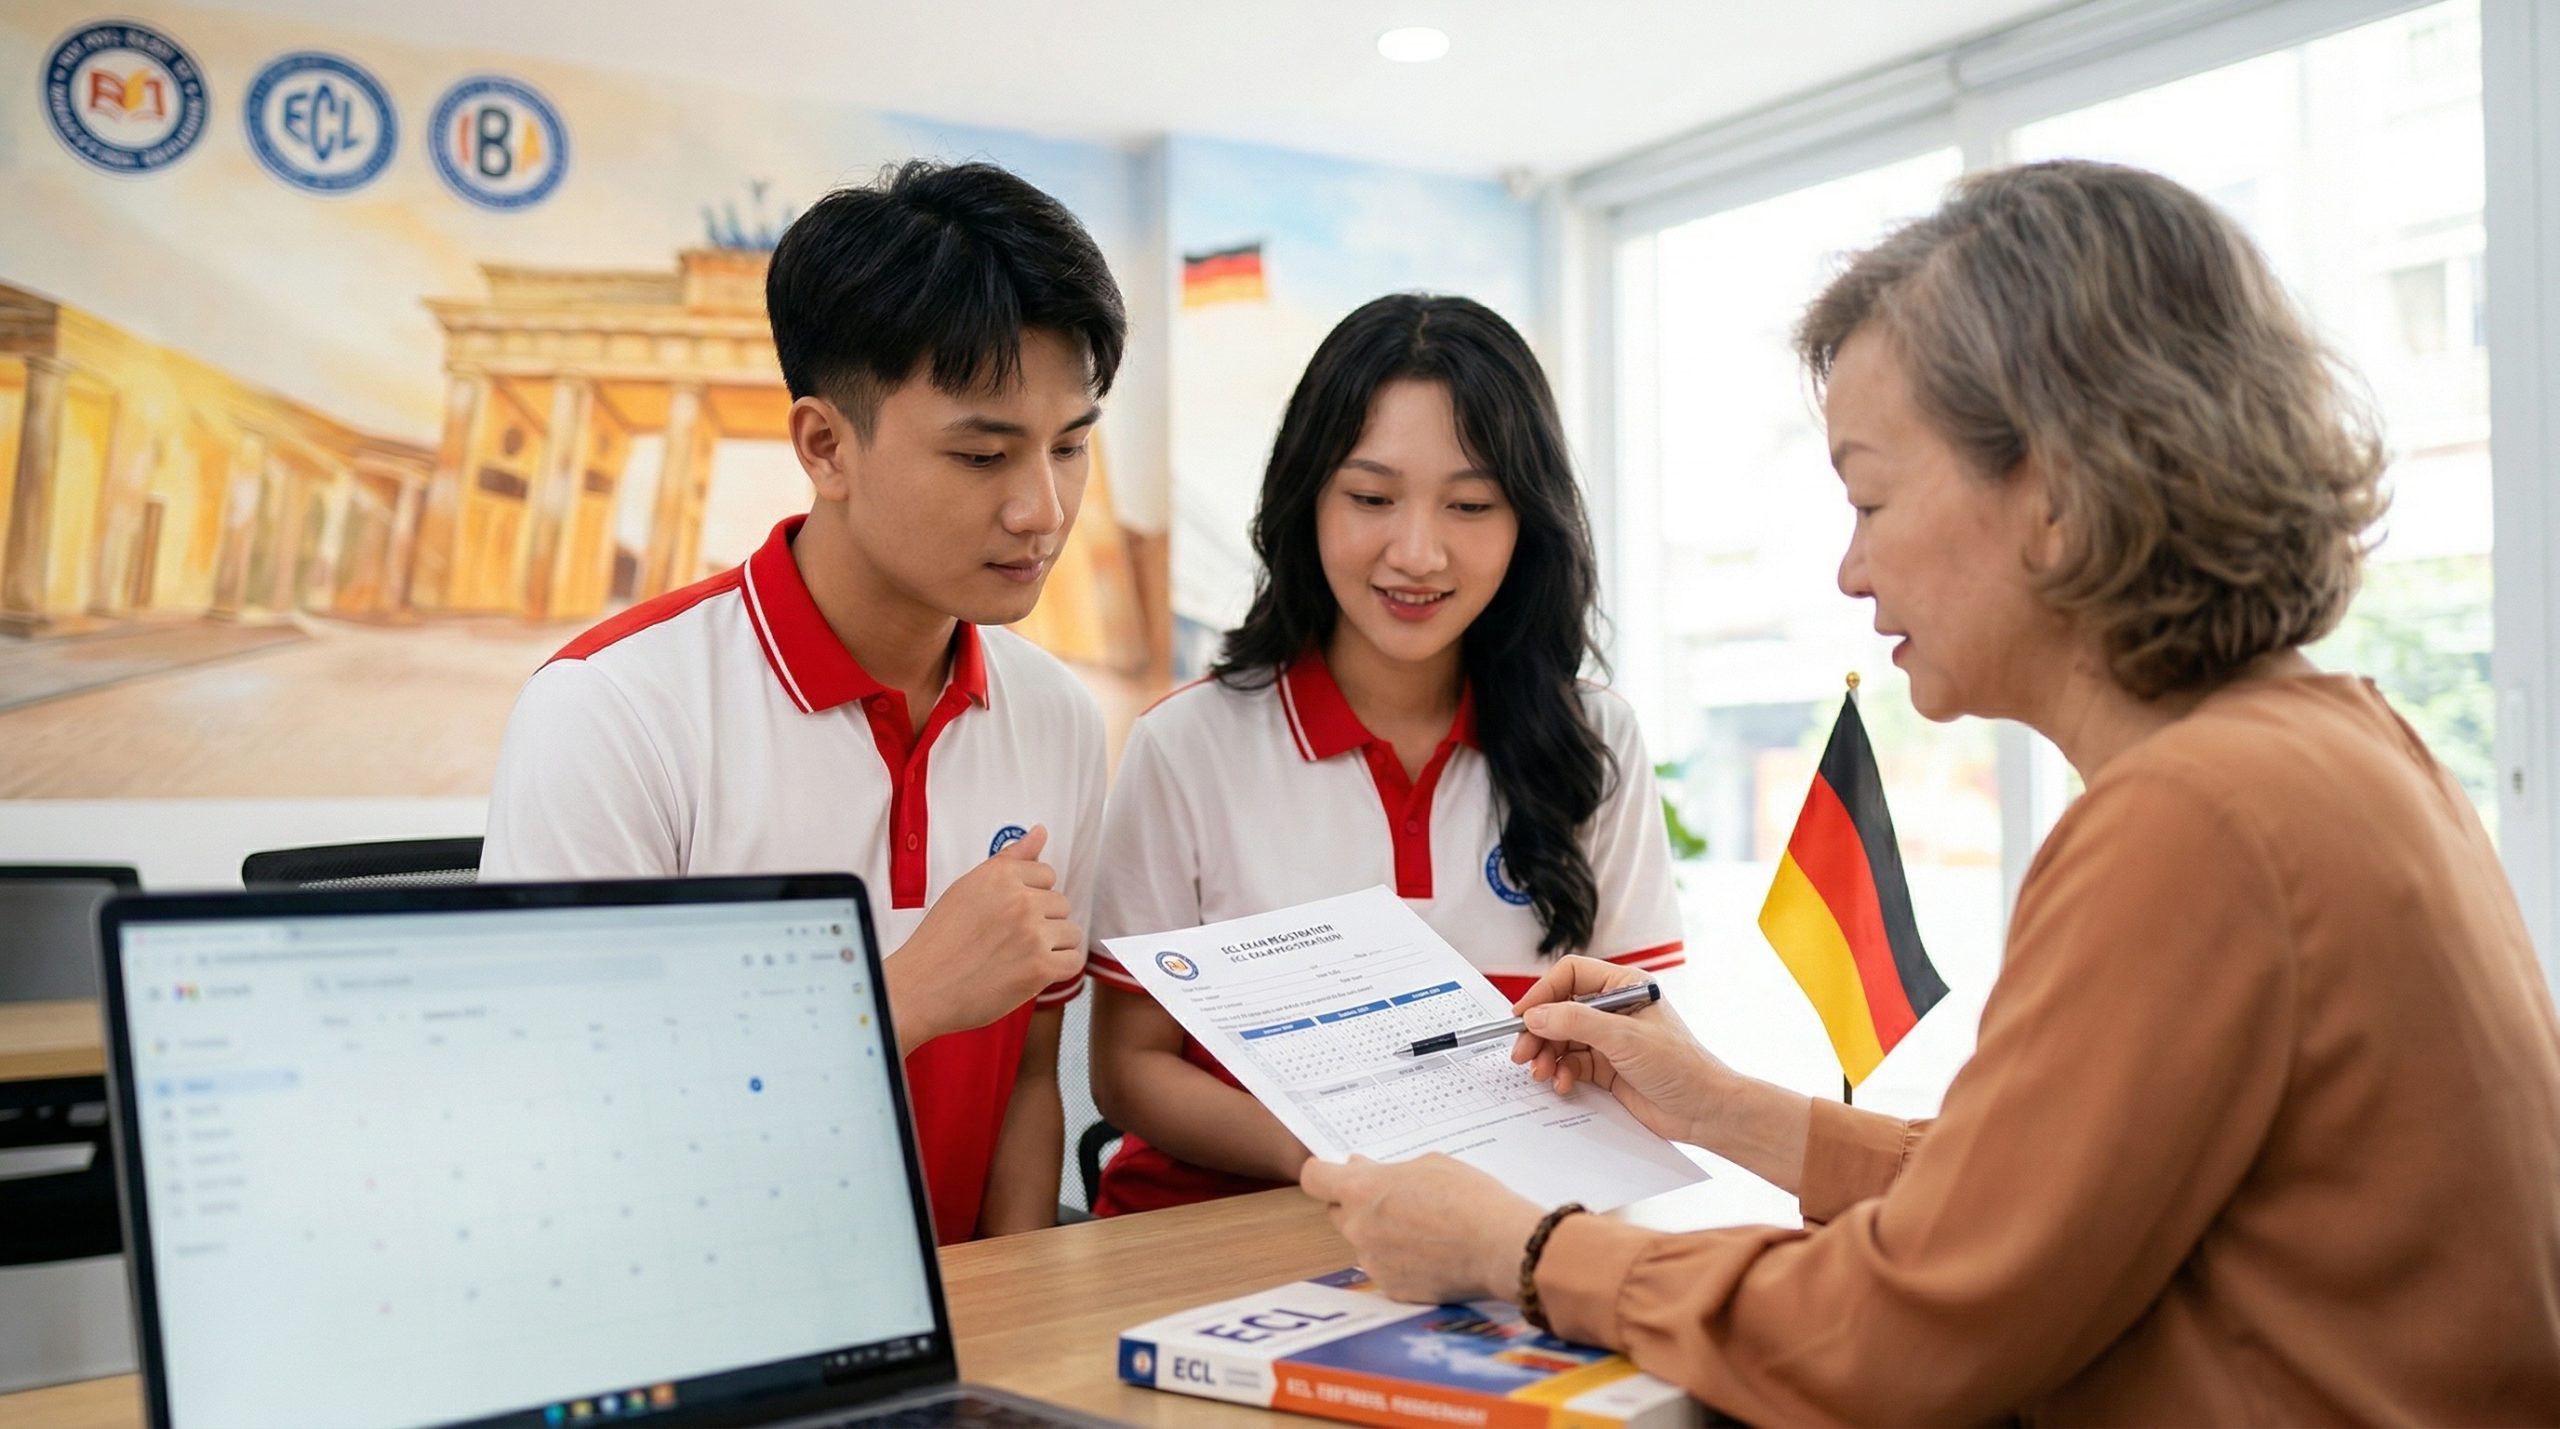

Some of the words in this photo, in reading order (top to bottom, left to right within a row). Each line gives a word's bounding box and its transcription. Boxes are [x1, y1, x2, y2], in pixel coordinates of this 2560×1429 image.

[284, 84, 360, 161] ECL
[1198, 1308, 1348, 1343] ECL
[1173, 1356, 1215, 1385] ECL
